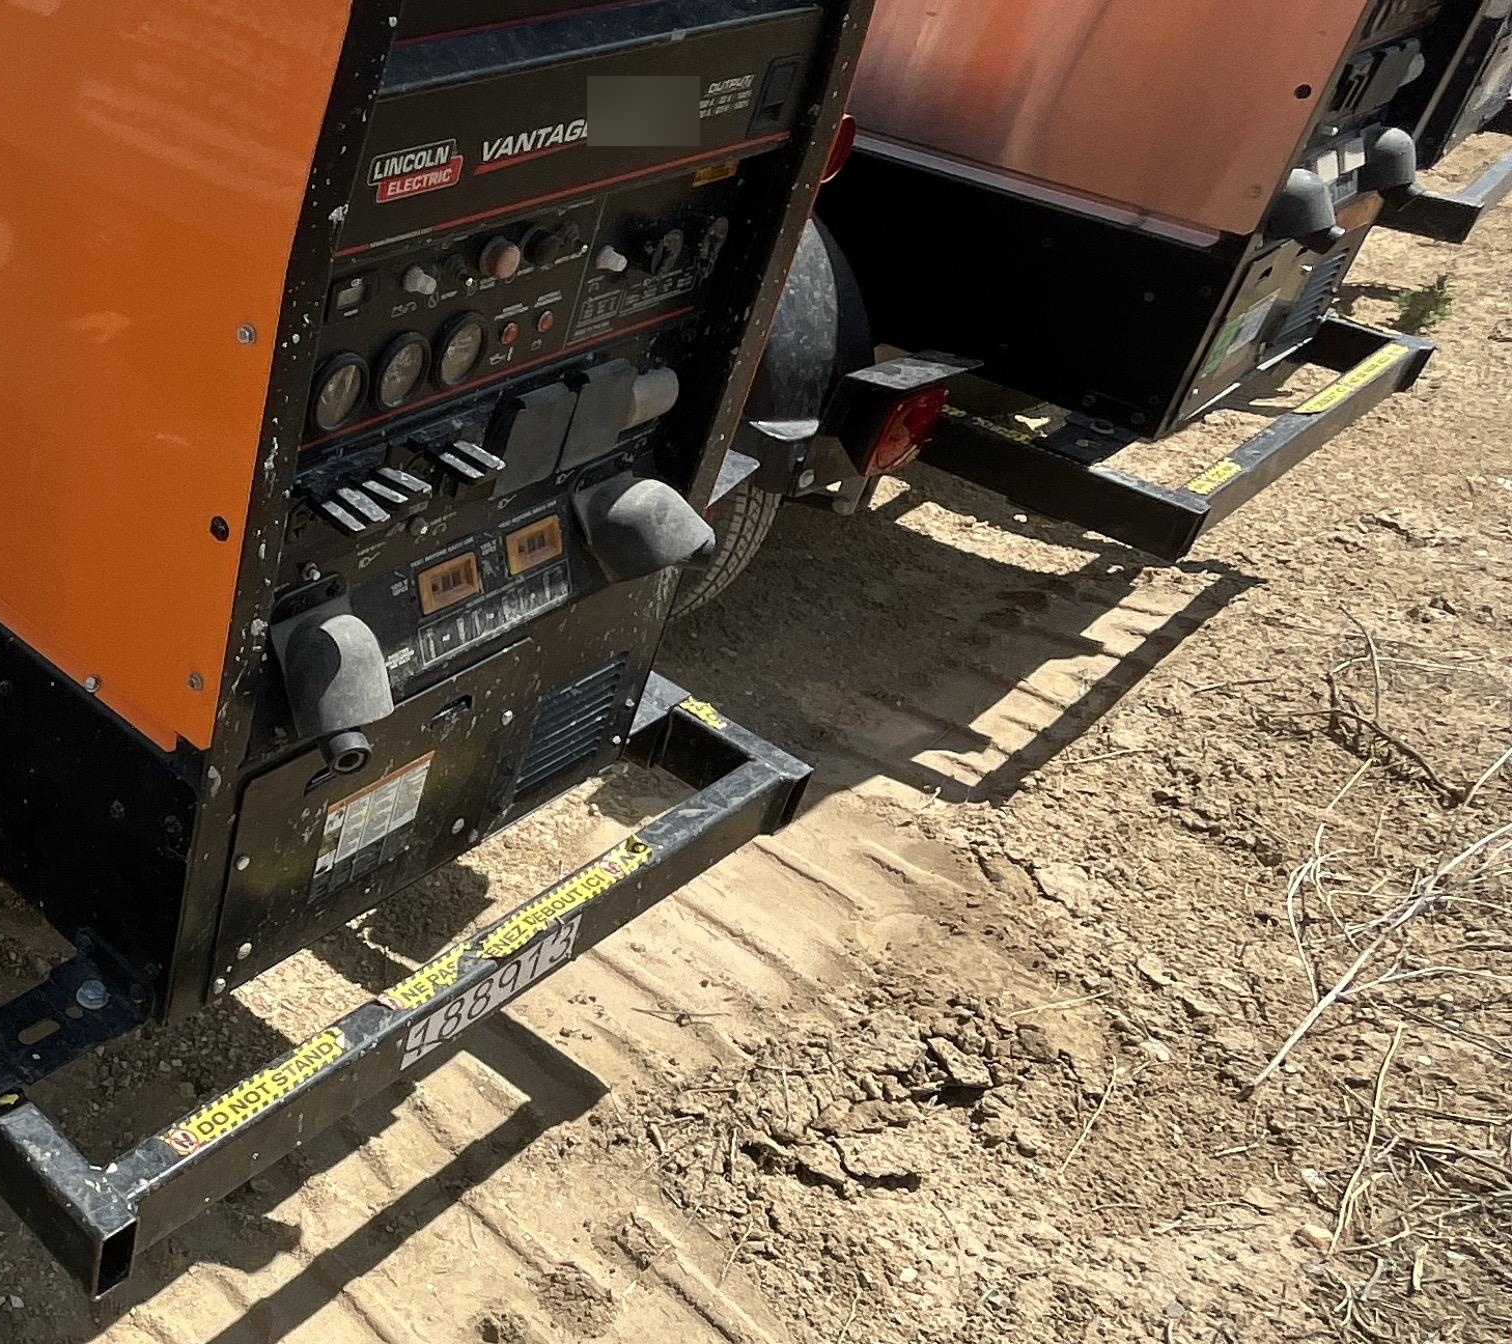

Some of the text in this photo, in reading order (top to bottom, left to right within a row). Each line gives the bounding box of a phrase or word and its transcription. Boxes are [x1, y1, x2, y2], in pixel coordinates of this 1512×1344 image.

[372, 145, 451, 181] LINCOLN
[387, 167, 453, 196] ELECTRIC
[402, 873, 607, 1003] NE PAS ENEZ DEBOUT ICI
[196, 1041, 334, 1136] DO NOT STAND
